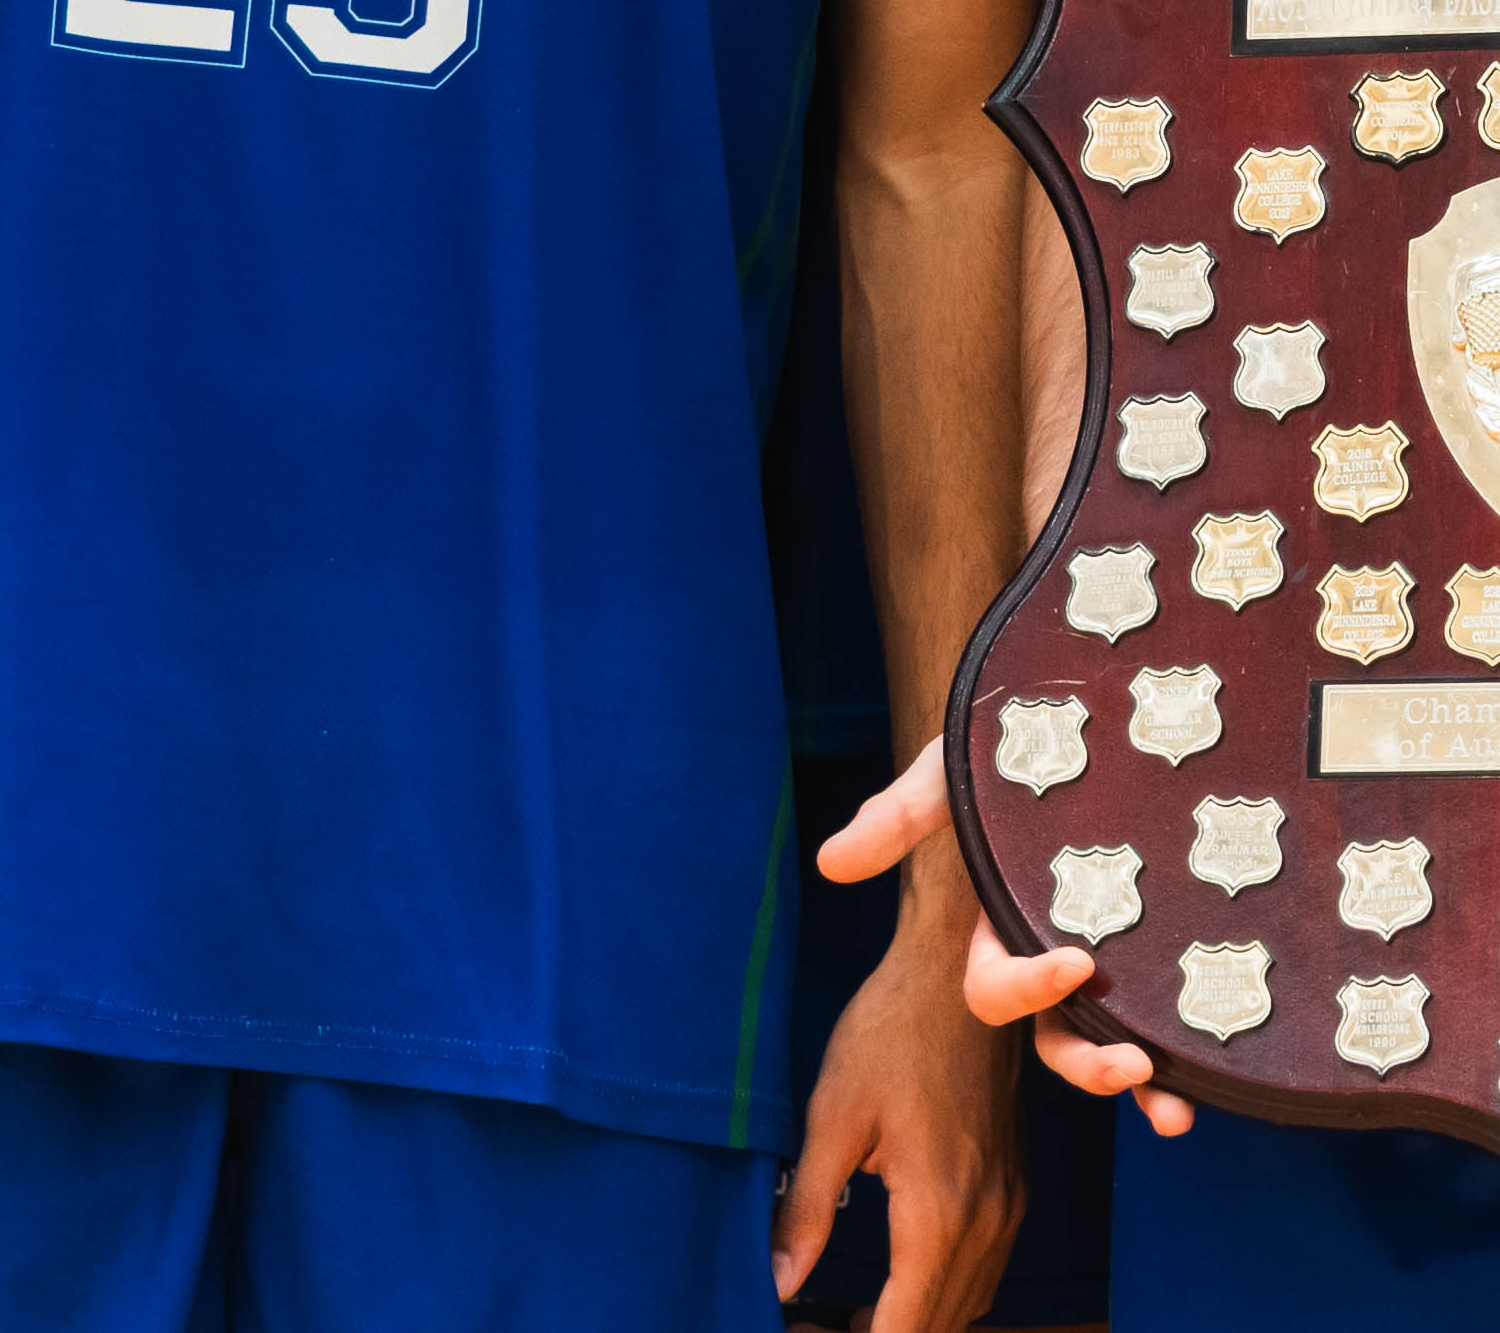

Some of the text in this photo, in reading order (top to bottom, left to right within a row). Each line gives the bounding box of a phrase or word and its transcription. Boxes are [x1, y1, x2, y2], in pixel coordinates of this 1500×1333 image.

[1267, 169, 1293, 181] LAKE
[1347, 448, 1371, 460] 2018
[1335, 460, 1384, 472] TRINITY
[1333, 471, 1387, 485] COLLEGE
[1351, 599, 1378, 612] LAKE
[1333, 614, 1396, 627] GINNINDERRA
[1399, 731, 1432, 758] of
[1360, 1012, 1404, 1023] SCHOOL
[1368, 1035, 1396, 1047] 1990
